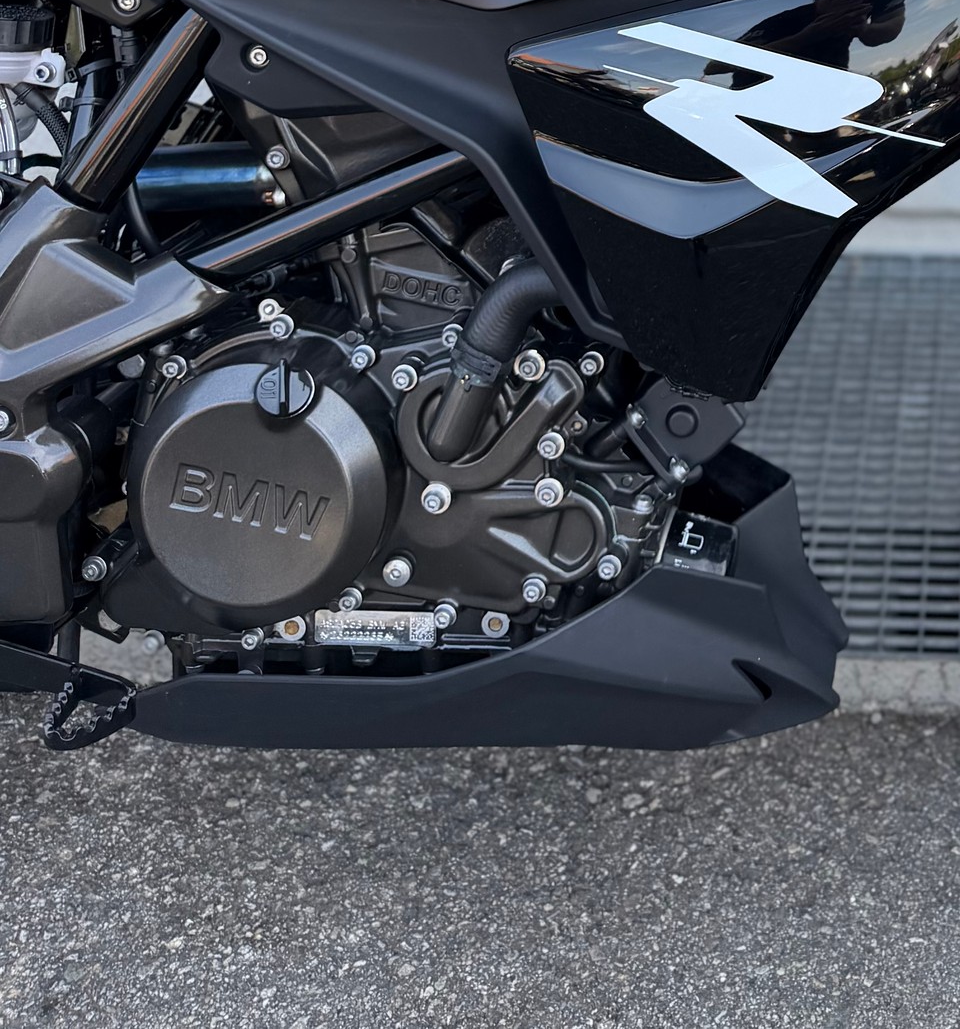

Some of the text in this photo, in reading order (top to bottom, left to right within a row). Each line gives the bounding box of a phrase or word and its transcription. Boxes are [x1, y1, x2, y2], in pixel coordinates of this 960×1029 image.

[603, 22, 946, 218] R
[382, 271, 461, 306] DOHC
[169, 463, 331, 541] BMW
